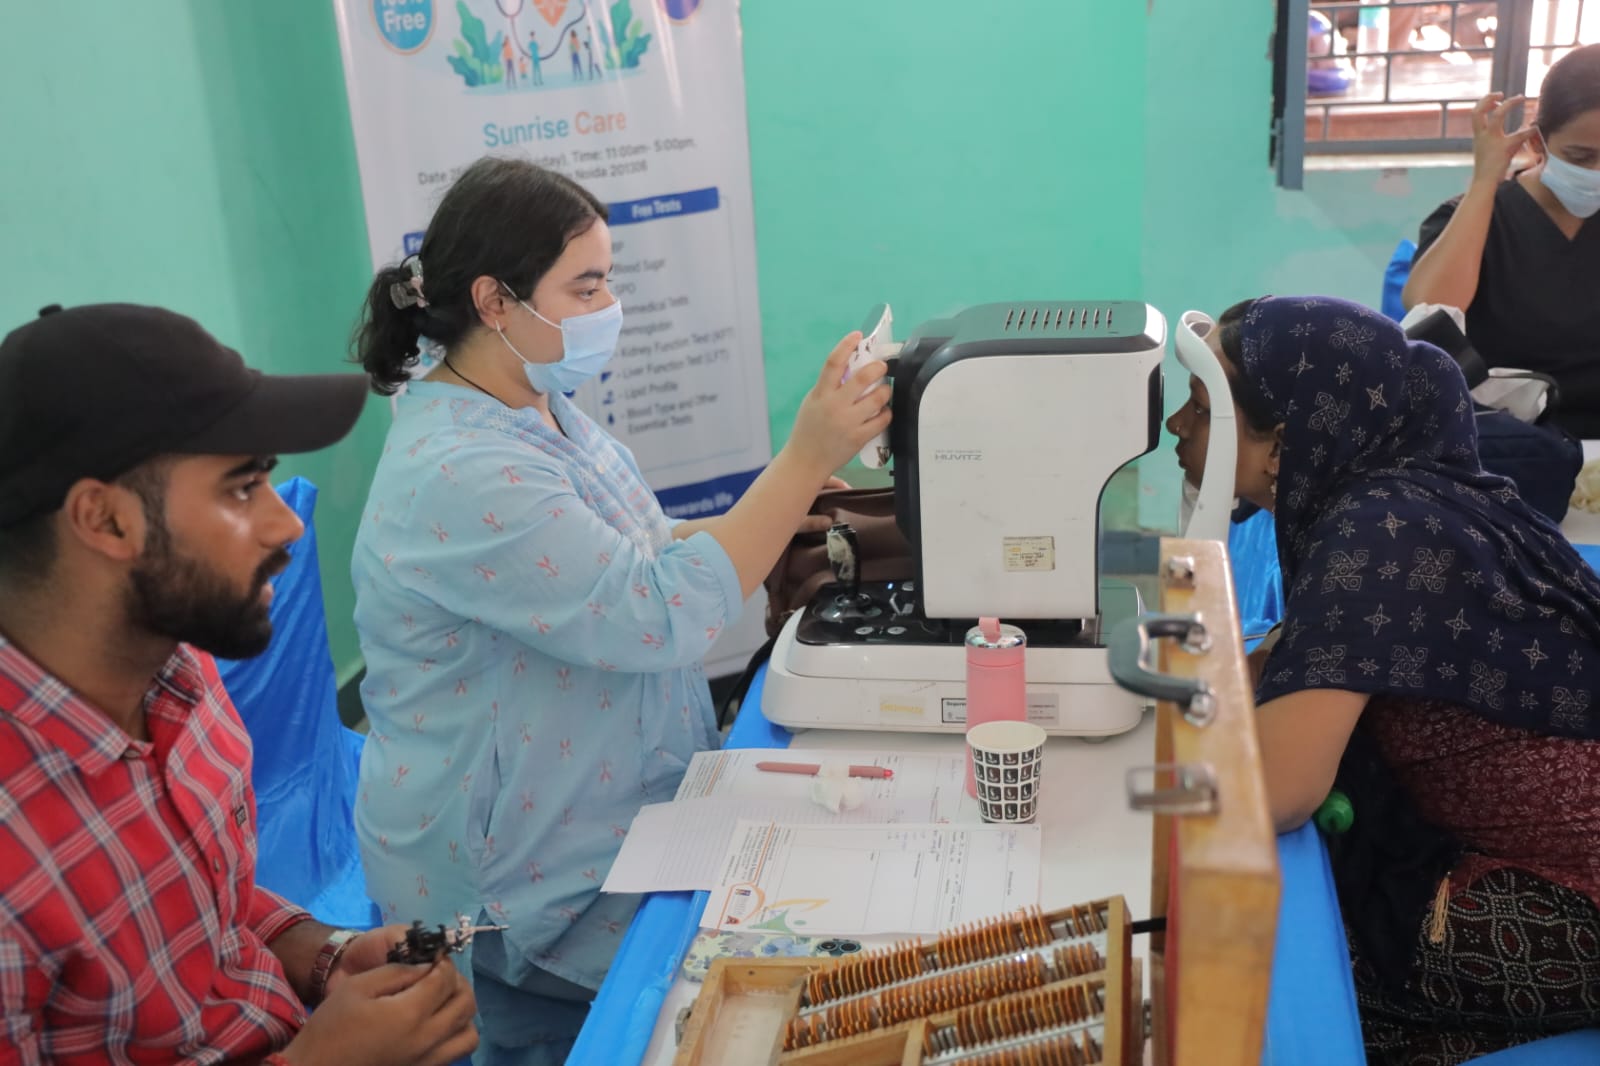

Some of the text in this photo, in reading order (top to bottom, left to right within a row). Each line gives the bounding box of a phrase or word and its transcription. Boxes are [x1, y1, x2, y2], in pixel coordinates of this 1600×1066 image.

[383, 10, 426, 32] Free
[483, 110, 627, 147] Sunrise Care
[418, 171, 447, 185] Date
[631, 199, 682, 219] Free Tests
